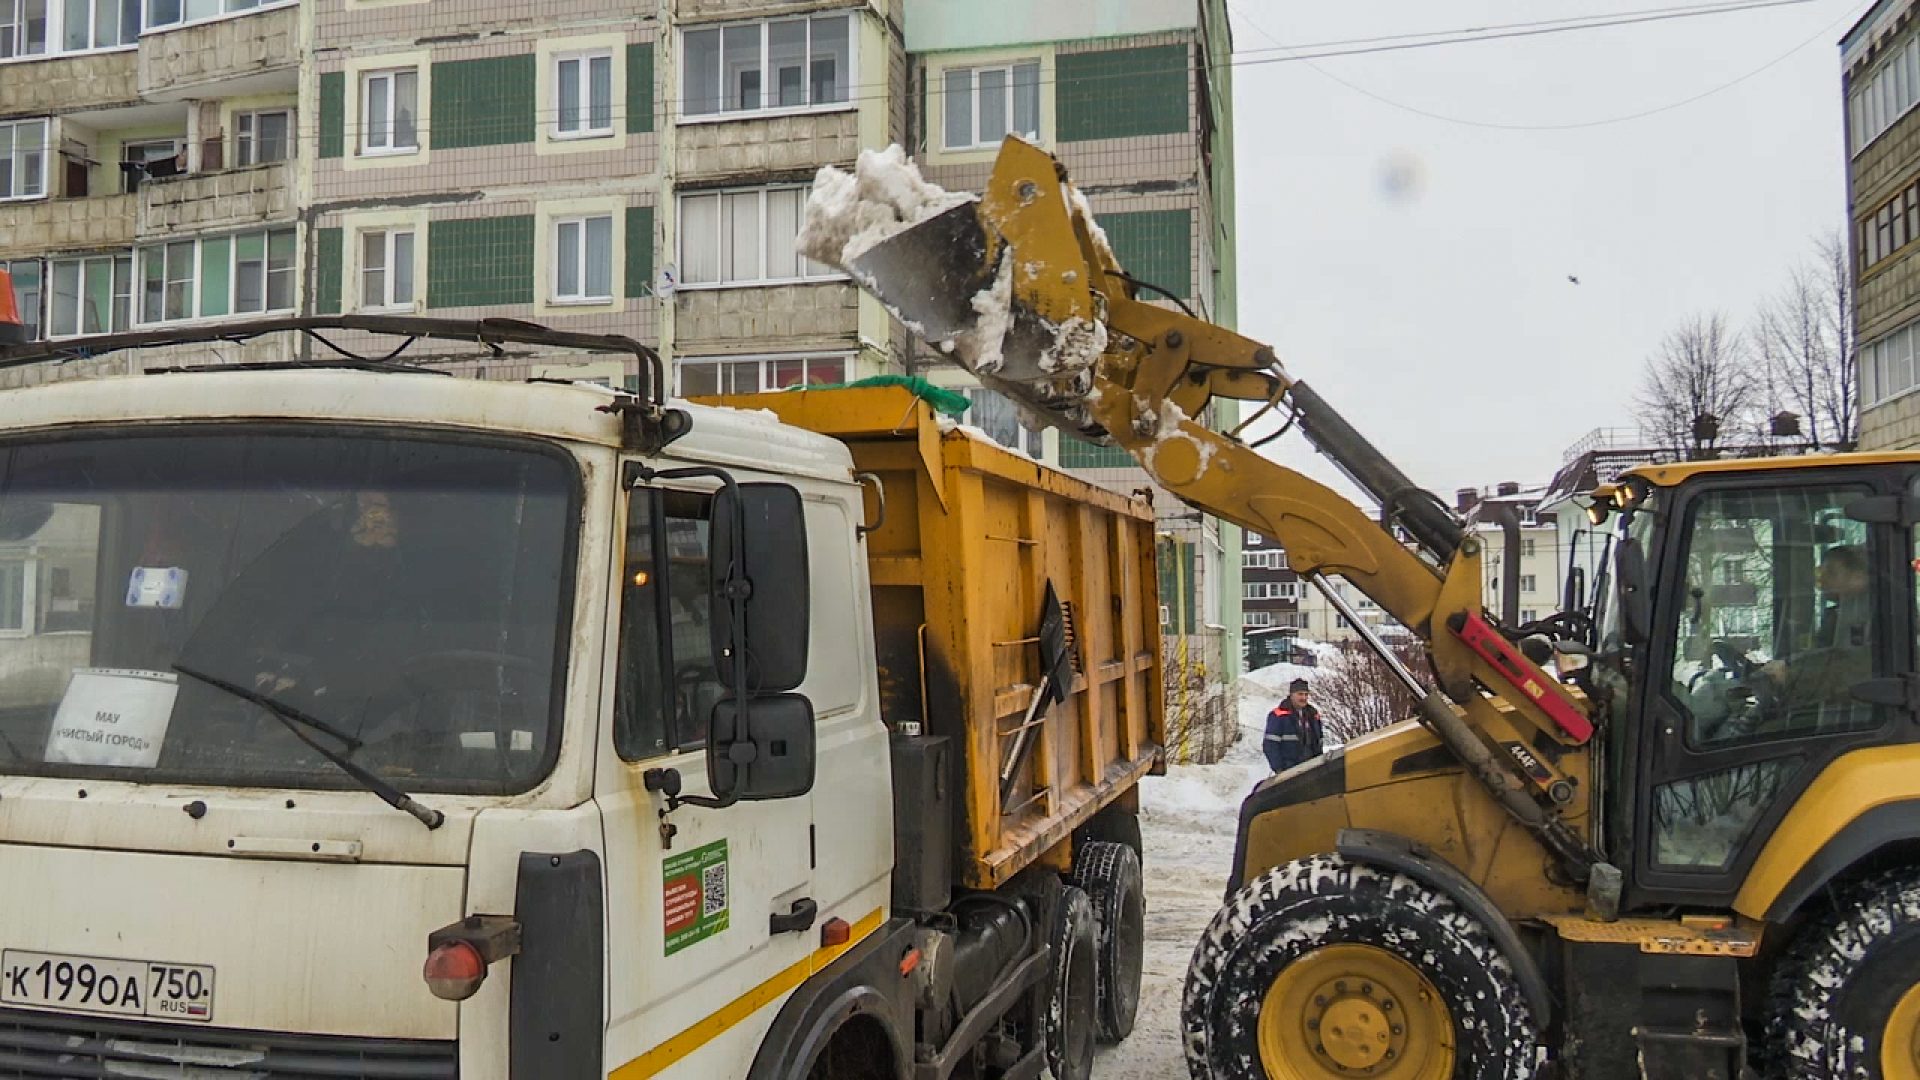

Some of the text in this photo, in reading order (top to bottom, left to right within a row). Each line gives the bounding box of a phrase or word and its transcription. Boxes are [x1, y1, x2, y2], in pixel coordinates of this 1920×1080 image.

[95, 711, 121, 724] МАУ
[106, 734, 150, 750] ГОРОД»
[1511, 746, 1537, 768] 444F
[151, 967, 202, 999] 750
[160, 1000, 187, 1013] RUS
